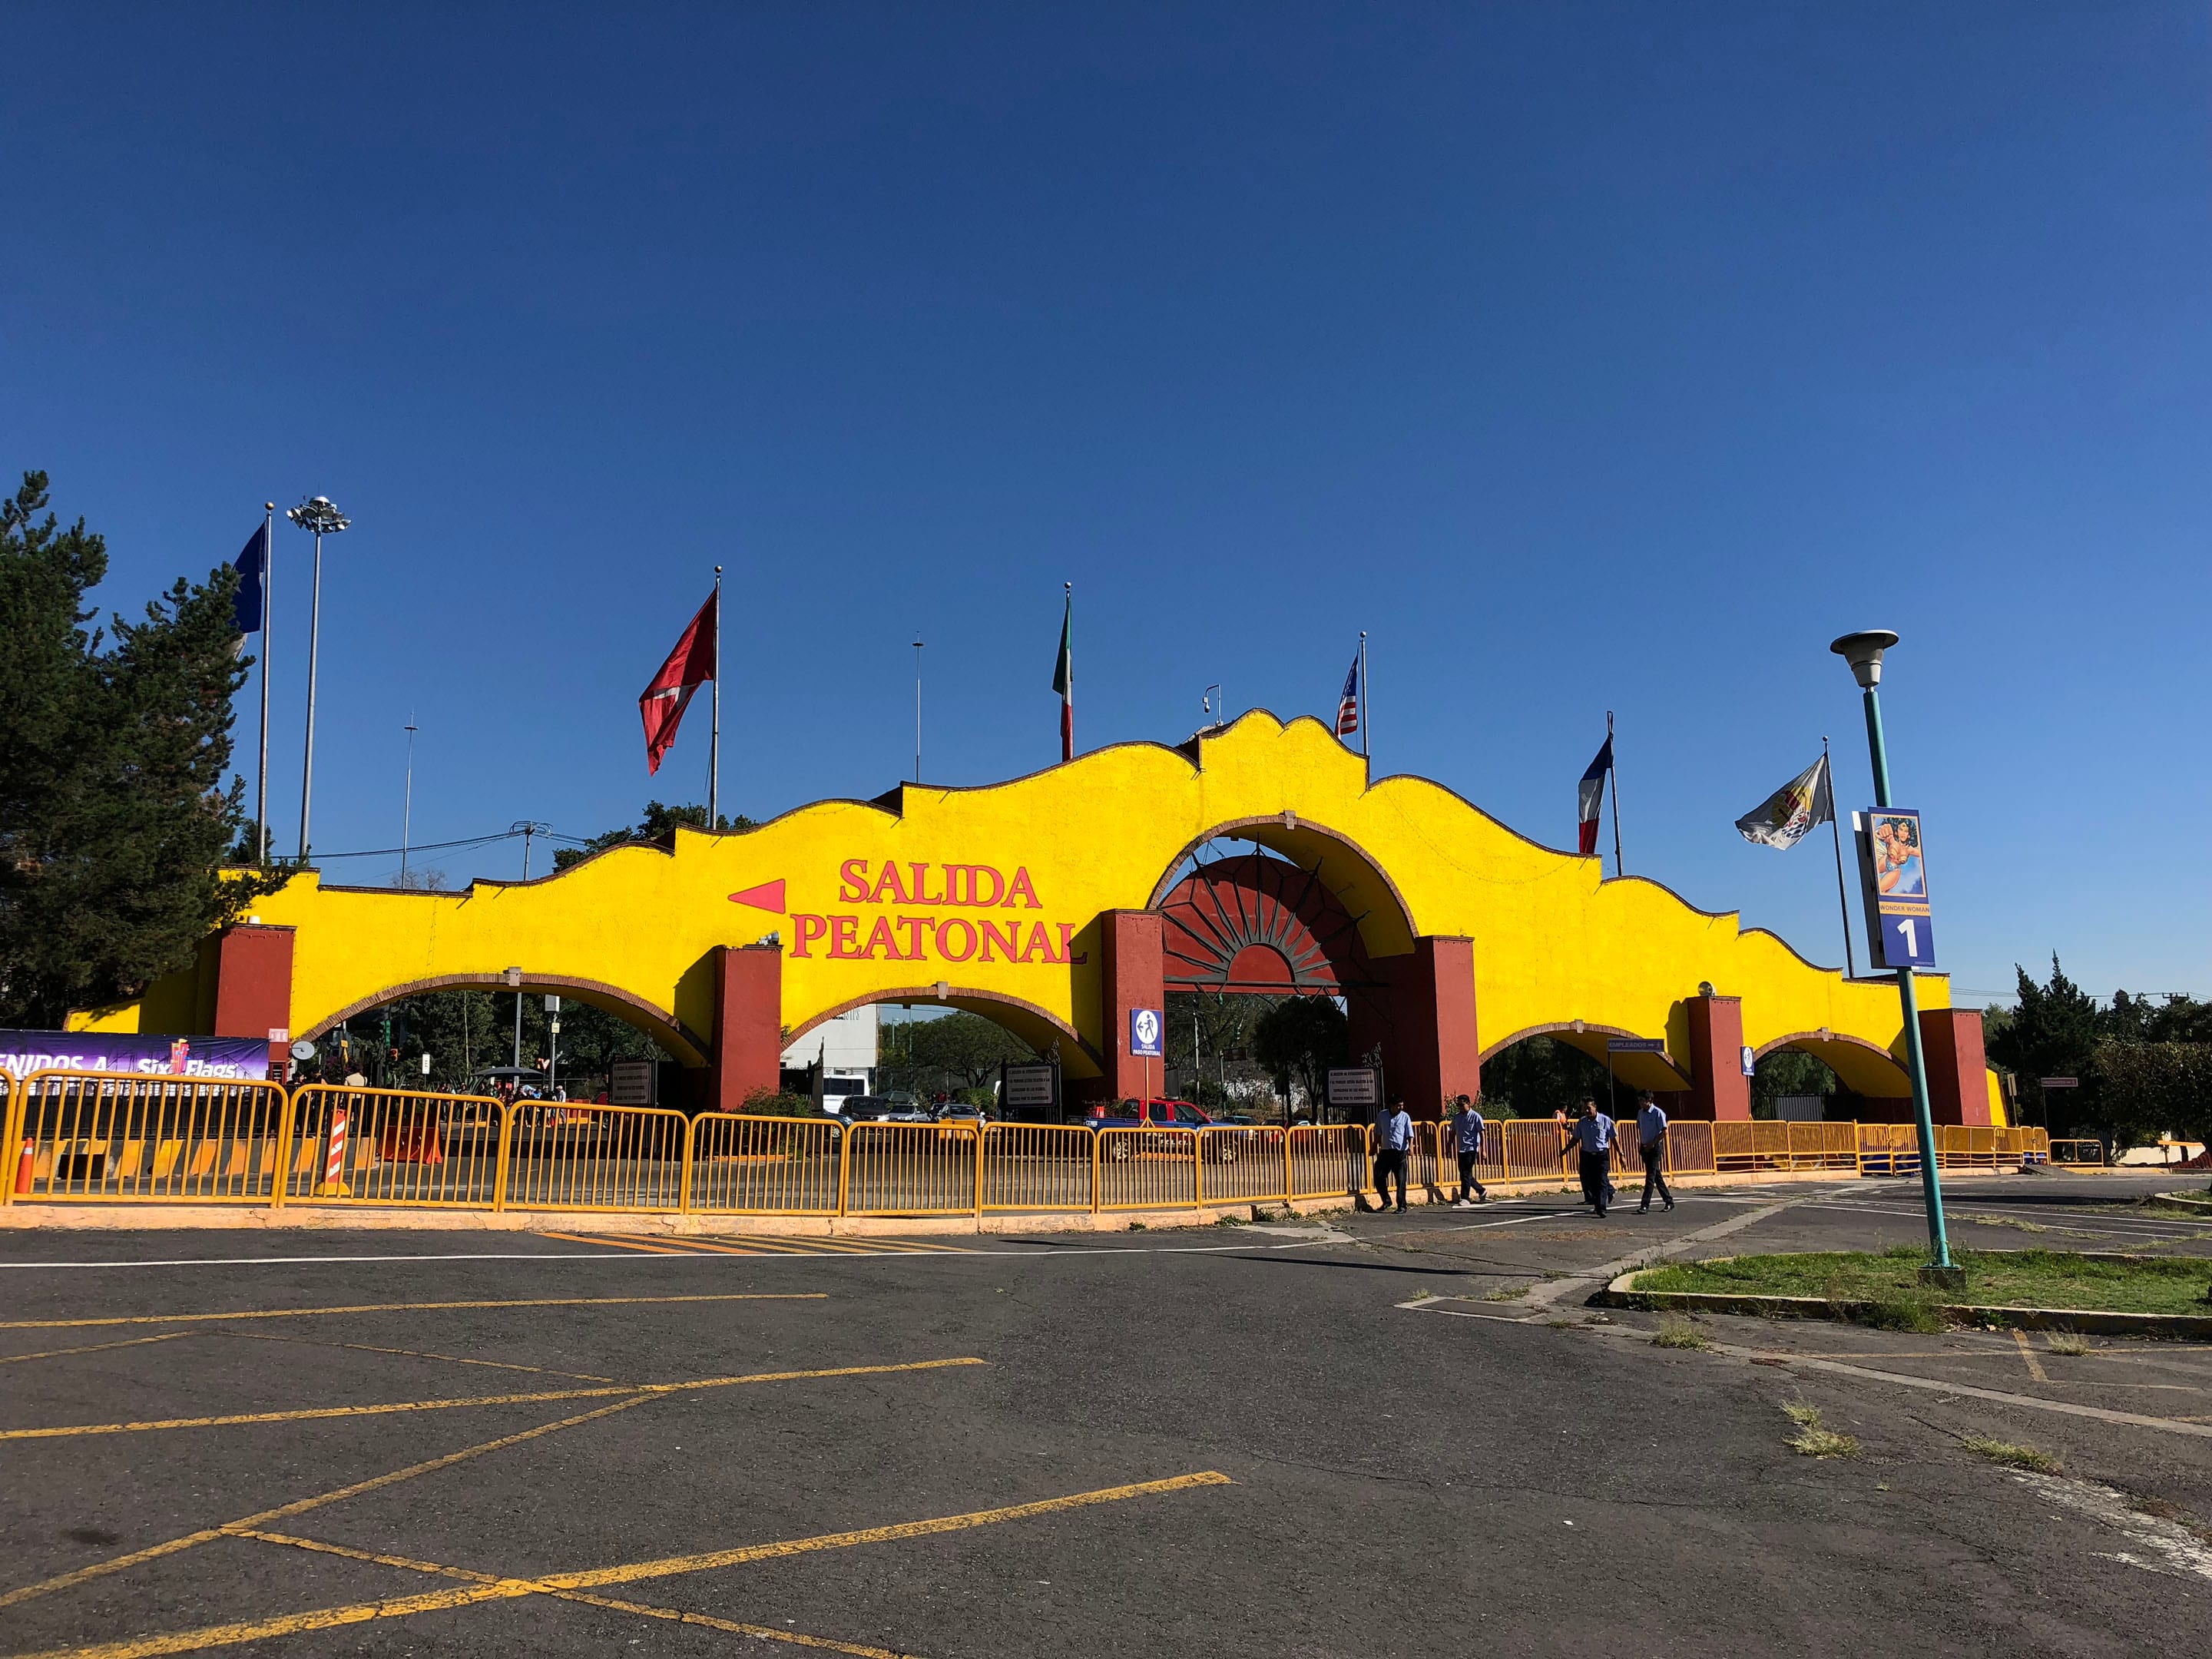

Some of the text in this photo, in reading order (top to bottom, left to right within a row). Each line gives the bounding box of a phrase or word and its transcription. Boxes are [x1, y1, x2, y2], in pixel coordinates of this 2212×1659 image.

[839, 859, 1043, 909] SALIDA
[790, 913, 1088, 965] PEATONAL
[1897, 919, 1918, 958] 1
[92, 1056, 108, 1071] A
[138, 1058, 171, 1075] Six
[185, 1059, 237, 1078] Flags
